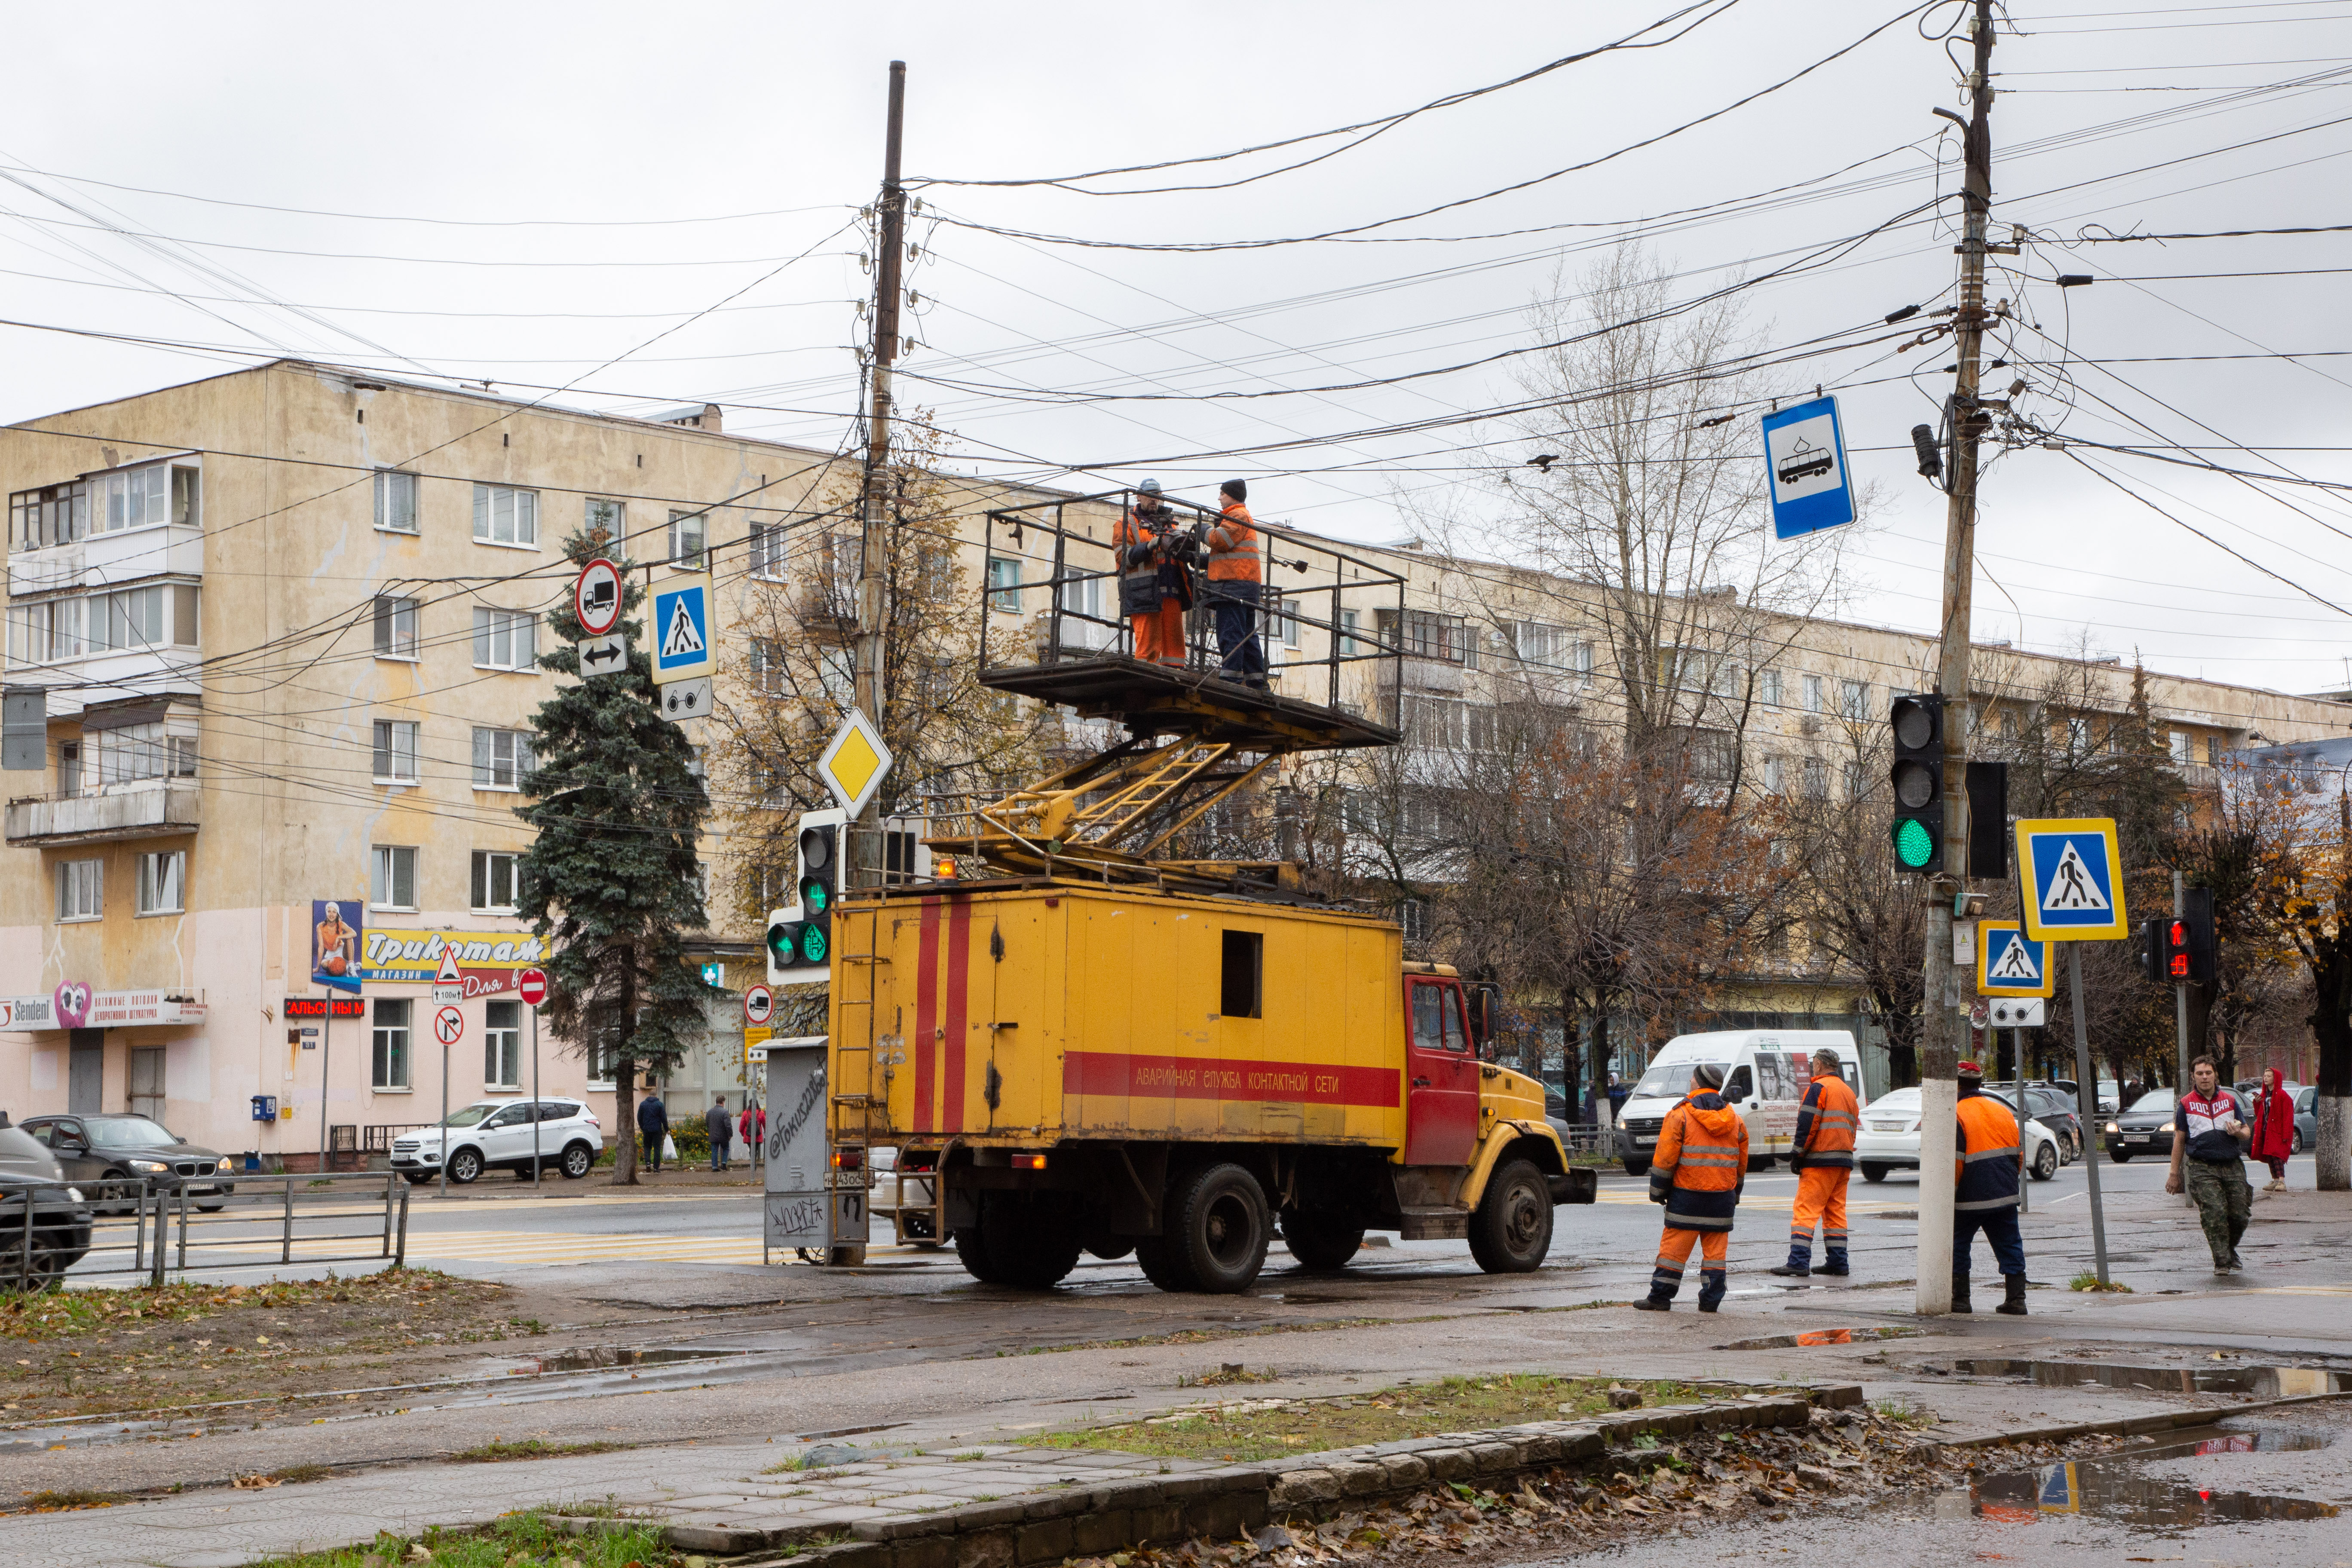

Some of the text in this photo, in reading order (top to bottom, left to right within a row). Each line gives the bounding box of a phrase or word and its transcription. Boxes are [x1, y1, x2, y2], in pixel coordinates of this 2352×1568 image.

[367, 933, 545, 966] Трикотаж
[372, 970, 421, 980] МАГАЗИН
[95, 995, 157, 1007] НАТЯЖНЫЕ ПОТОЛКИ
[15, 1000, 49, 1021] Sendeni
[95, 1008, 157, 1023] ДЕКОРАТИВНАЯ ШТУКАТУРКА
[1136, 1065, 1339, 1093] АВАРИЙНАЯ СЛУЖБА КОНТАКТНОЙ СЕТИ
